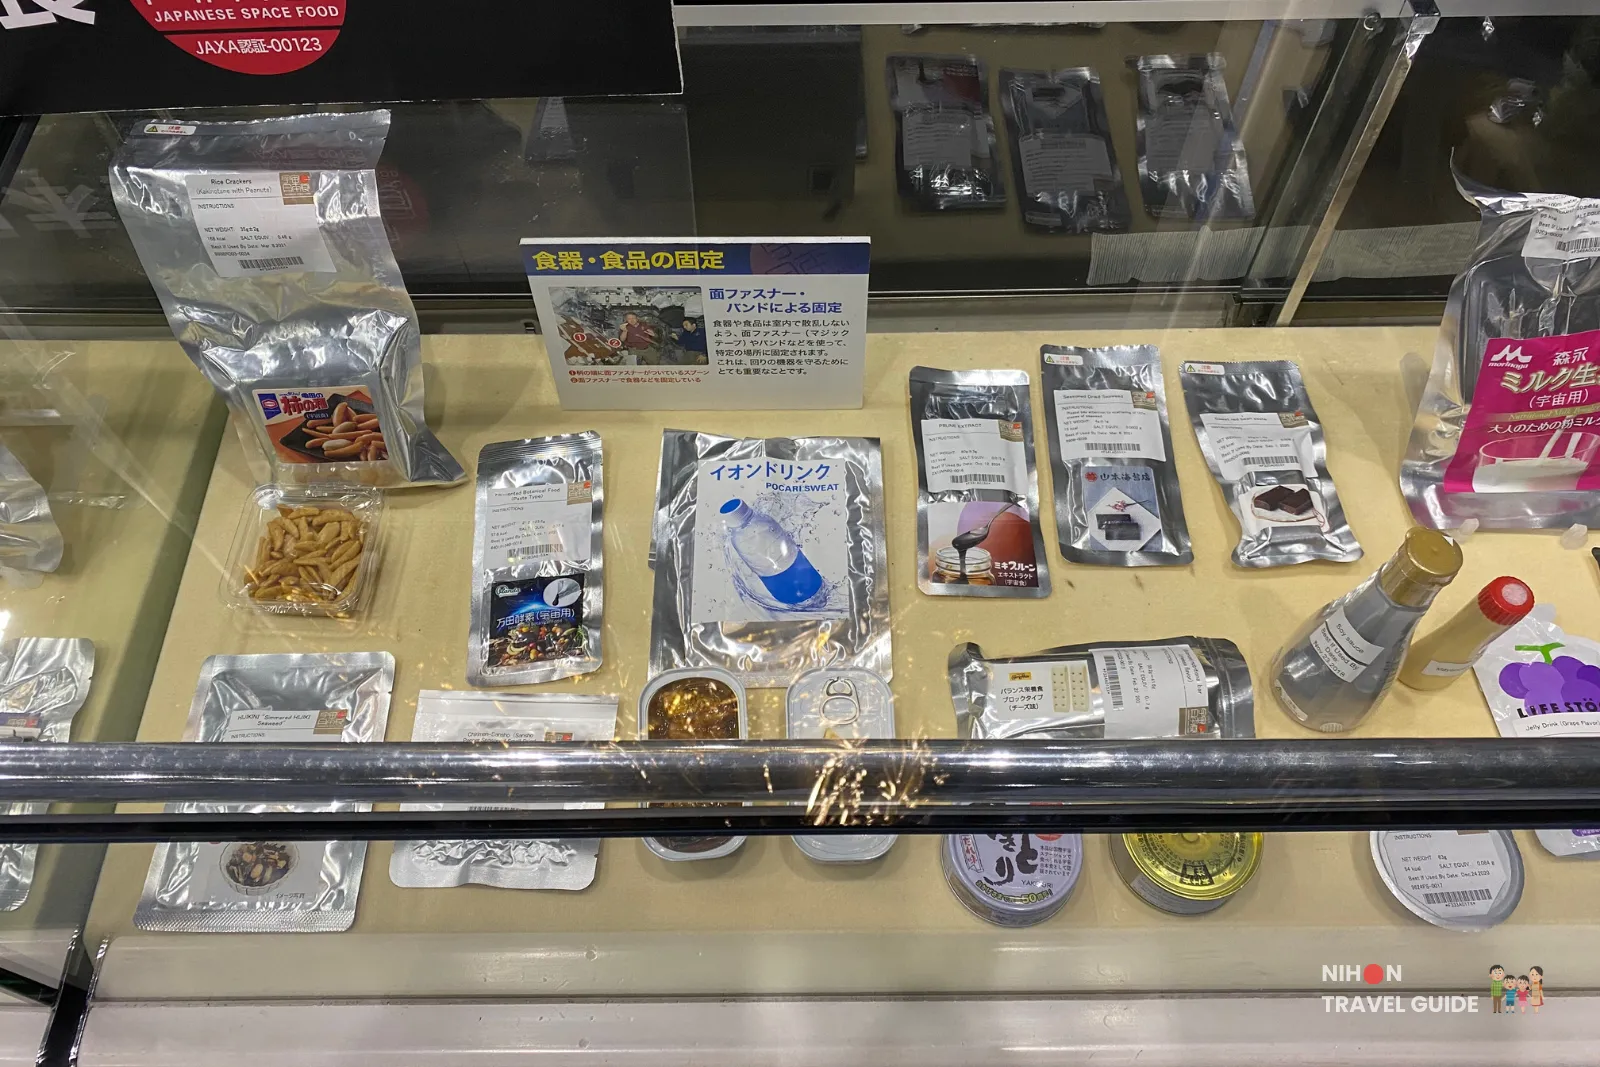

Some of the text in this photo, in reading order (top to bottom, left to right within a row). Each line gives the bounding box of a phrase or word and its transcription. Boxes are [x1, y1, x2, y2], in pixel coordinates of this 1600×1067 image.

[154, 5, 339, 23] JAPANESE SPACE FOOD
[196, 37, 323, 55] JAXA認証-00123
[532, 250, 725, 271] 食器・食品の固定
[709, 288, 805, 300] 面ファスナー・
[727, 302, 842, 314] バンドによる固定
[713, 320, 850, 328] 食器や食品は室内で散乱しない
[716, 349, 829, 357] 特定の場所に固定されます。
[1553, 347, 1589, 367] 森永
[1488, 361, 1529, 370] morinaga
[718, 368, 807, 376] とても重要なことです。
[1500, 362, 1600, 394] ミルク生
[710, 461, 831, 481] イオンドリンク
[766, 483, 839, 492] POCARI SWEAT
[994, 561, 1036, 572] ミキプルーン
[1336, 623, 1365, 654] Soy sauce
[1320, 627, 1332, 644] Best
[1334, 645, 1350, 665] Used
[1349, 660, 1360, 671] By
[1003, 694, 1044, 703] ブロックタイプ
[1525, 724, 1540, 732] Jelly
